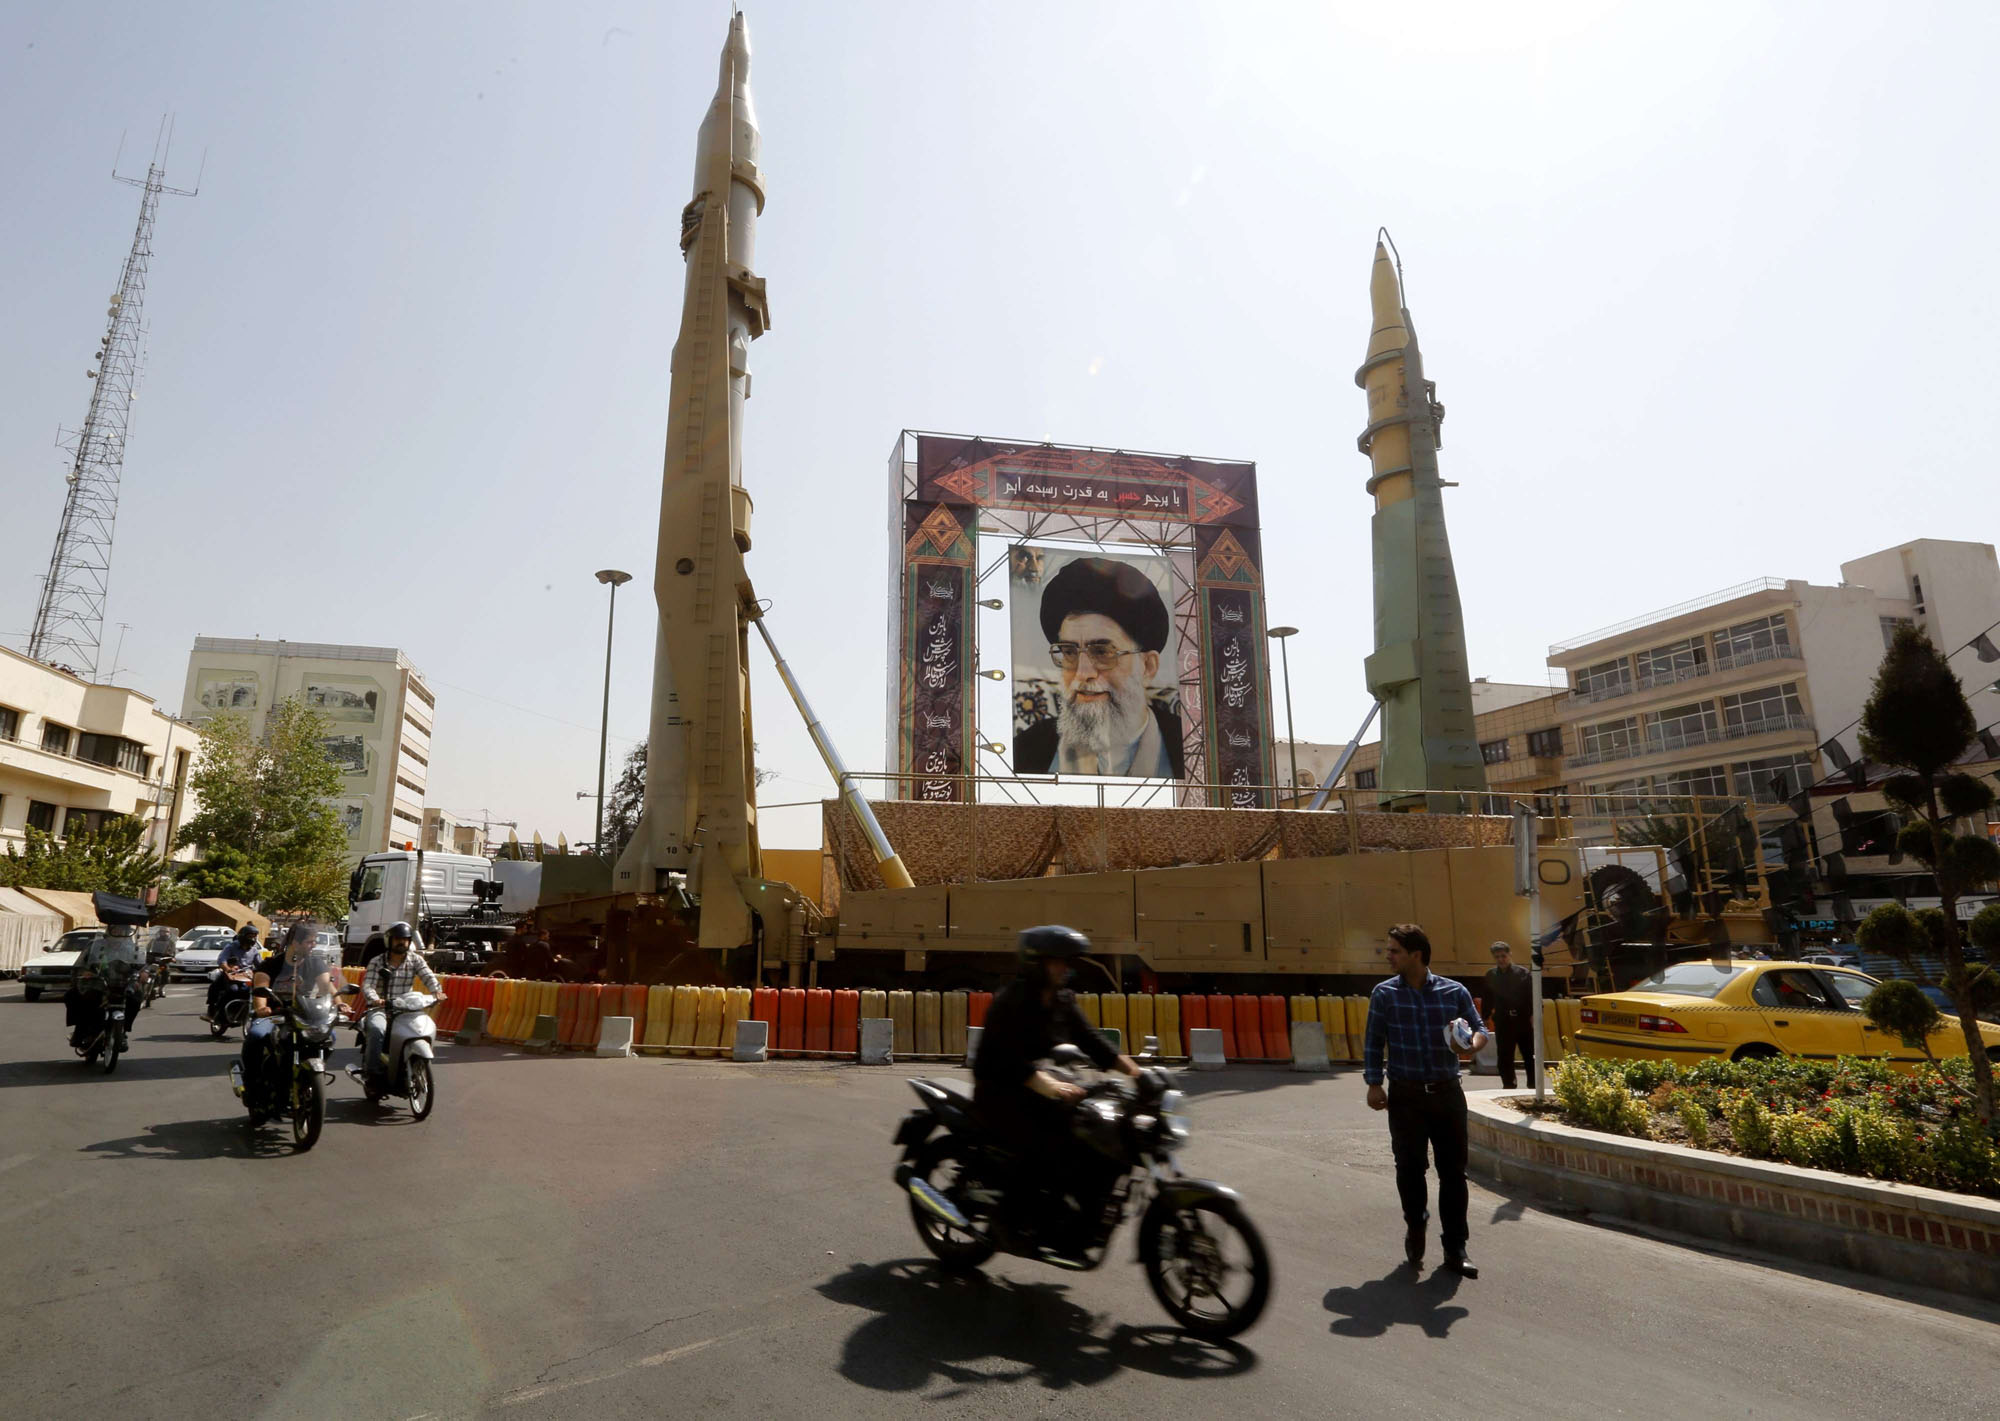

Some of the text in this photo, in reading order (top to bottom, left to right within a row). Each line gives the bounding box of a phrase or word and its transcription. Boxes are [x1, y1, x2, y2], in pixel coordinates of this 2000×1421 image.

[1063, 484, 1093, 500] قدرت
[1096, 490, 1108, 502] به
[1143, 492, 1169, 507] پرچم
[1172, 489, 1181, 507] با
